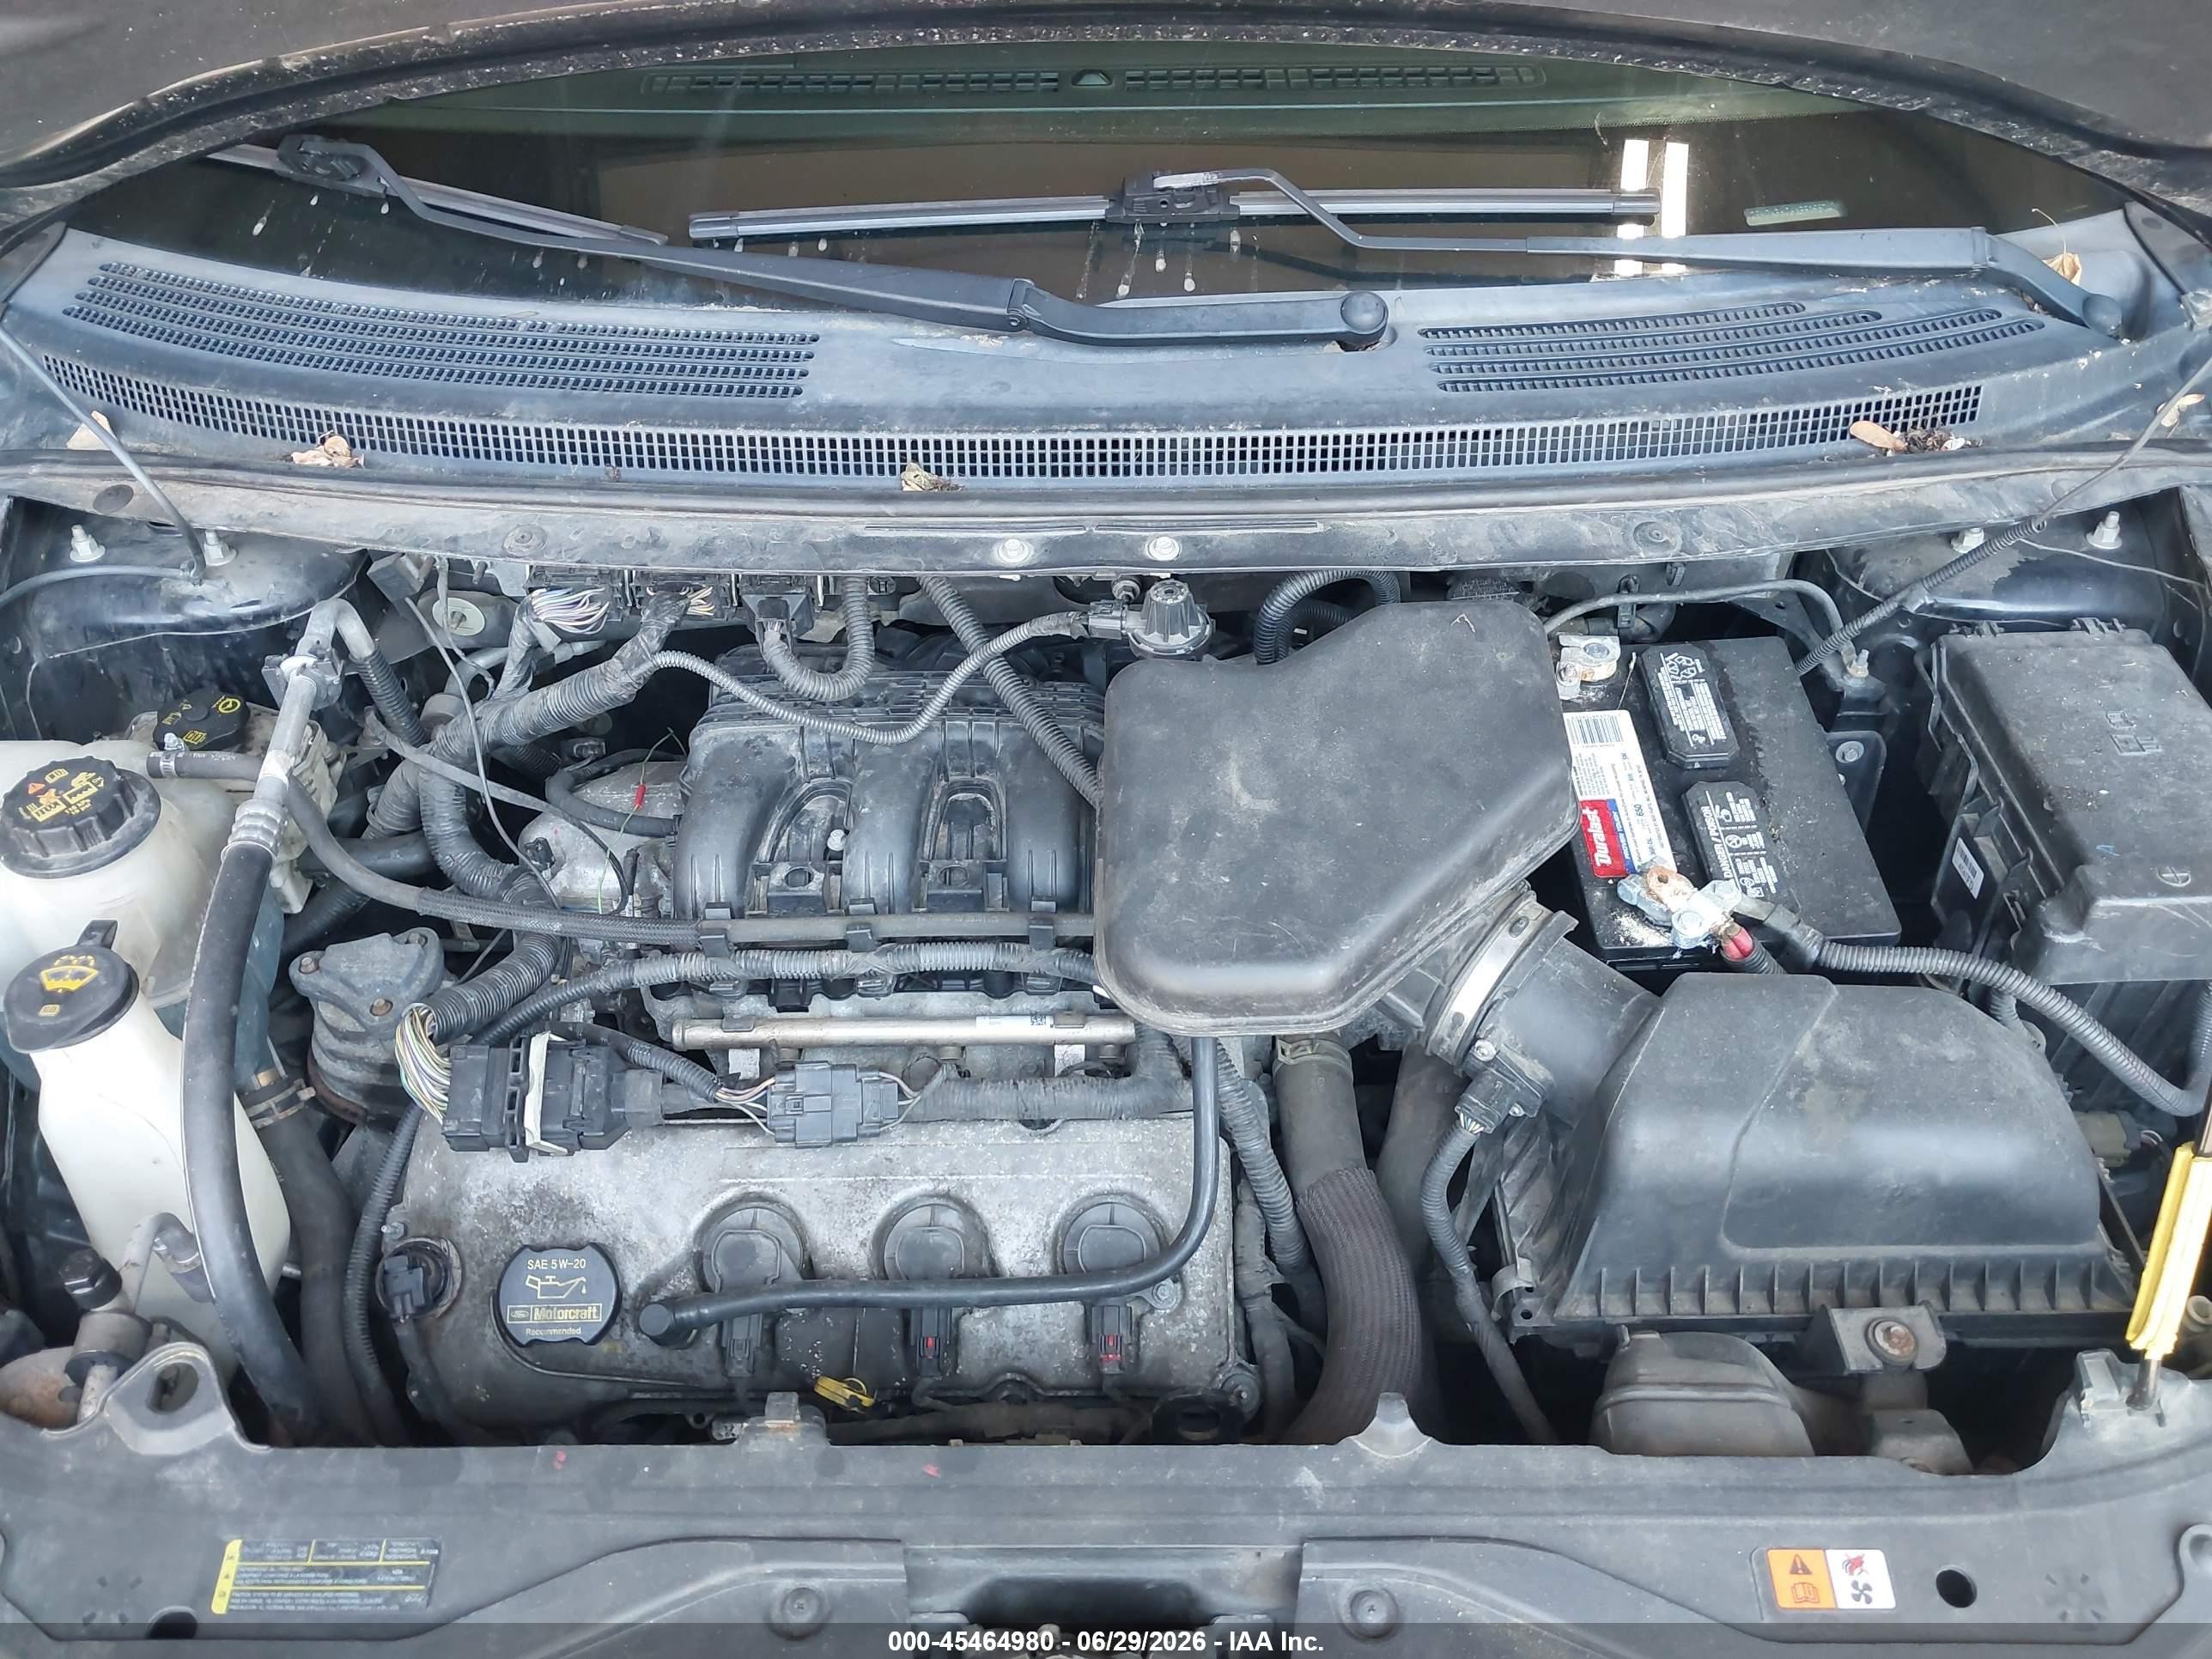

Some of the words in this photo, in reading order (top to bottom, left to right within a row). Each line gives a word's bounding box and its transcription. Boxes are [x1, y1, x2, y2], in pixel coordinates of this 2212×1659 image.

[1633, 803, 1644, 817] 650
[1612, 811, 1623, 831] TOUGH
[1700, 805, 1718, 836] POISON
[1581, 807, 1612, 866] Duralast
[1712, 843, 1733, 878] DANGER
[526, 1260, 548, 1269] SAE
[533, 1305, 599, 1321] Motorcraft
